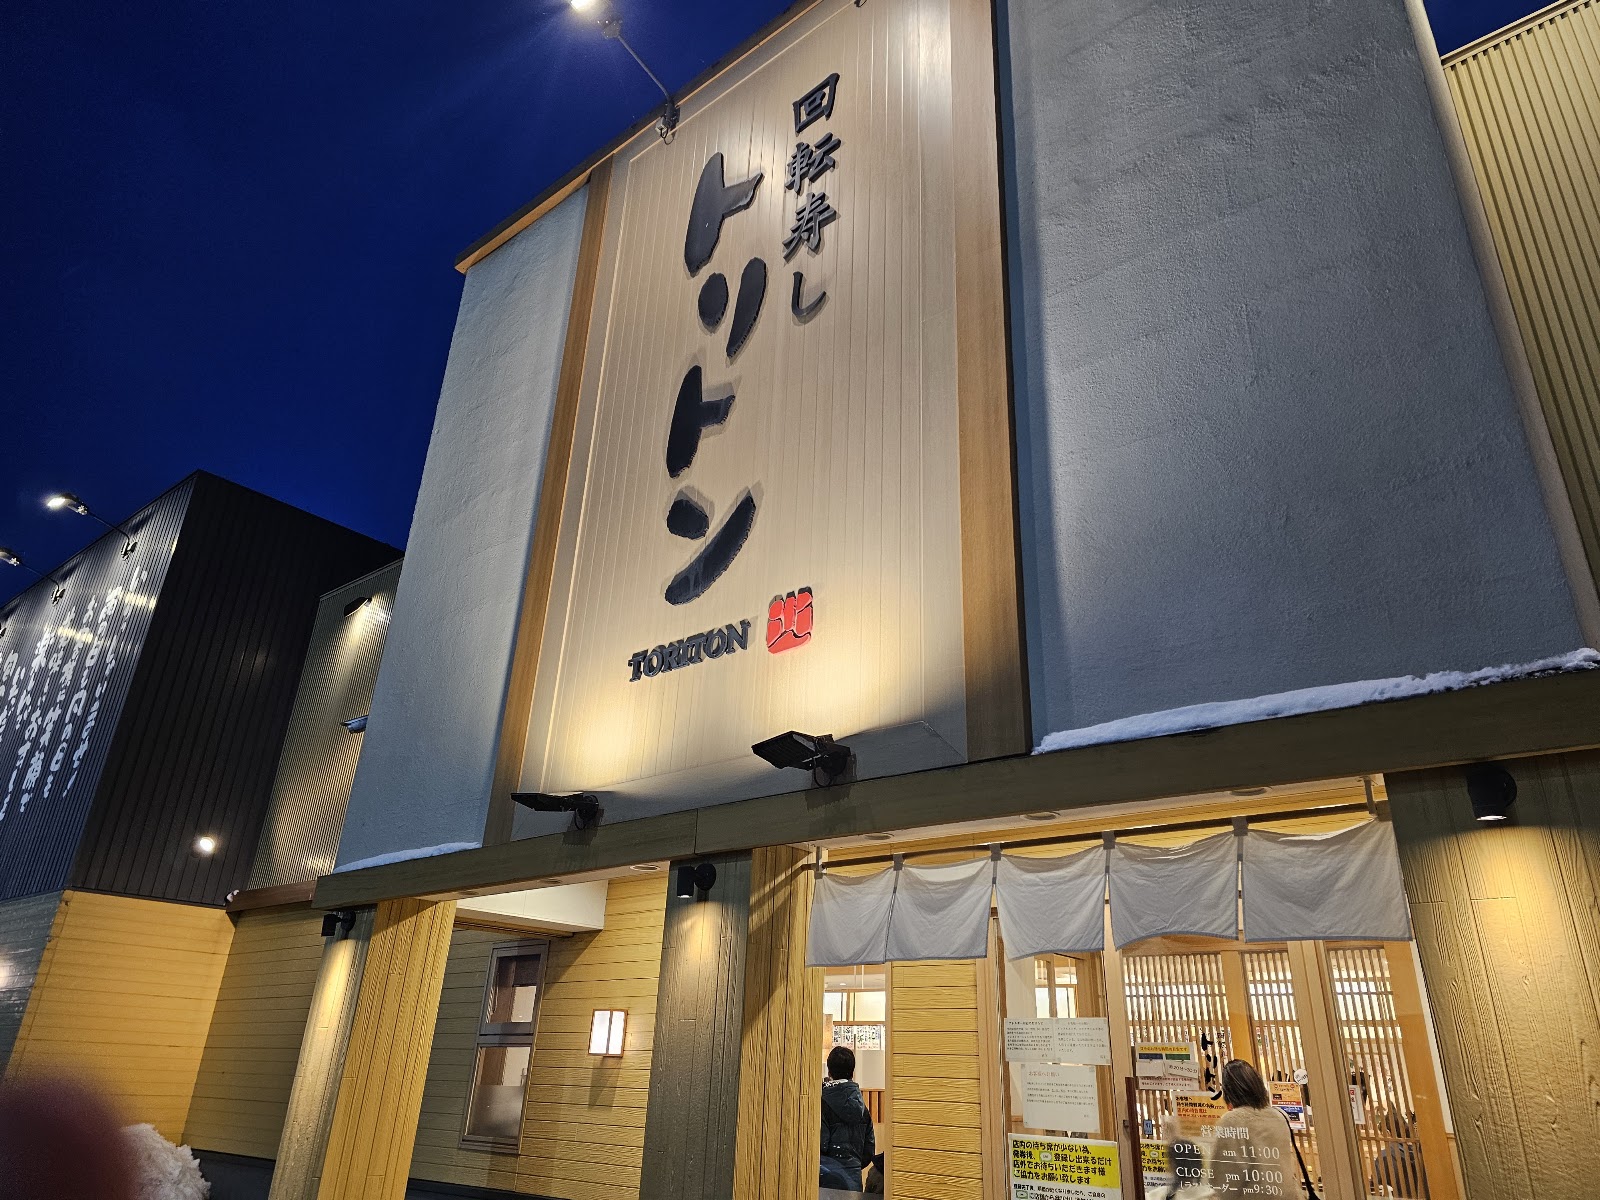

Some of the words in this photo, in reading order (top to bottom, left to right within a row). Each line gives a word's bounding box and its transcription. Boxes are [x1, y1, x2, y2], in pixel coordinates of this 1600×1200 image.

[782, 72, 842, 319] 回転寿し
[664, 151, 767, 606] トリトン
[628, 618, 752, 683] TORITON
[1173, 1143, 1211, 1155] OPEN
[1222, 1149, 1237, 1157] am
[1240, 1146, 1280, 1160] 11:00
[1200, 1125, 1249, 1140] 営業時間
[1175, 1166, 1215, 1179] CLOSE
[1225, 1172, 1241, 1183] pm
[1242, 1169, 1283, 1184] 10:00
